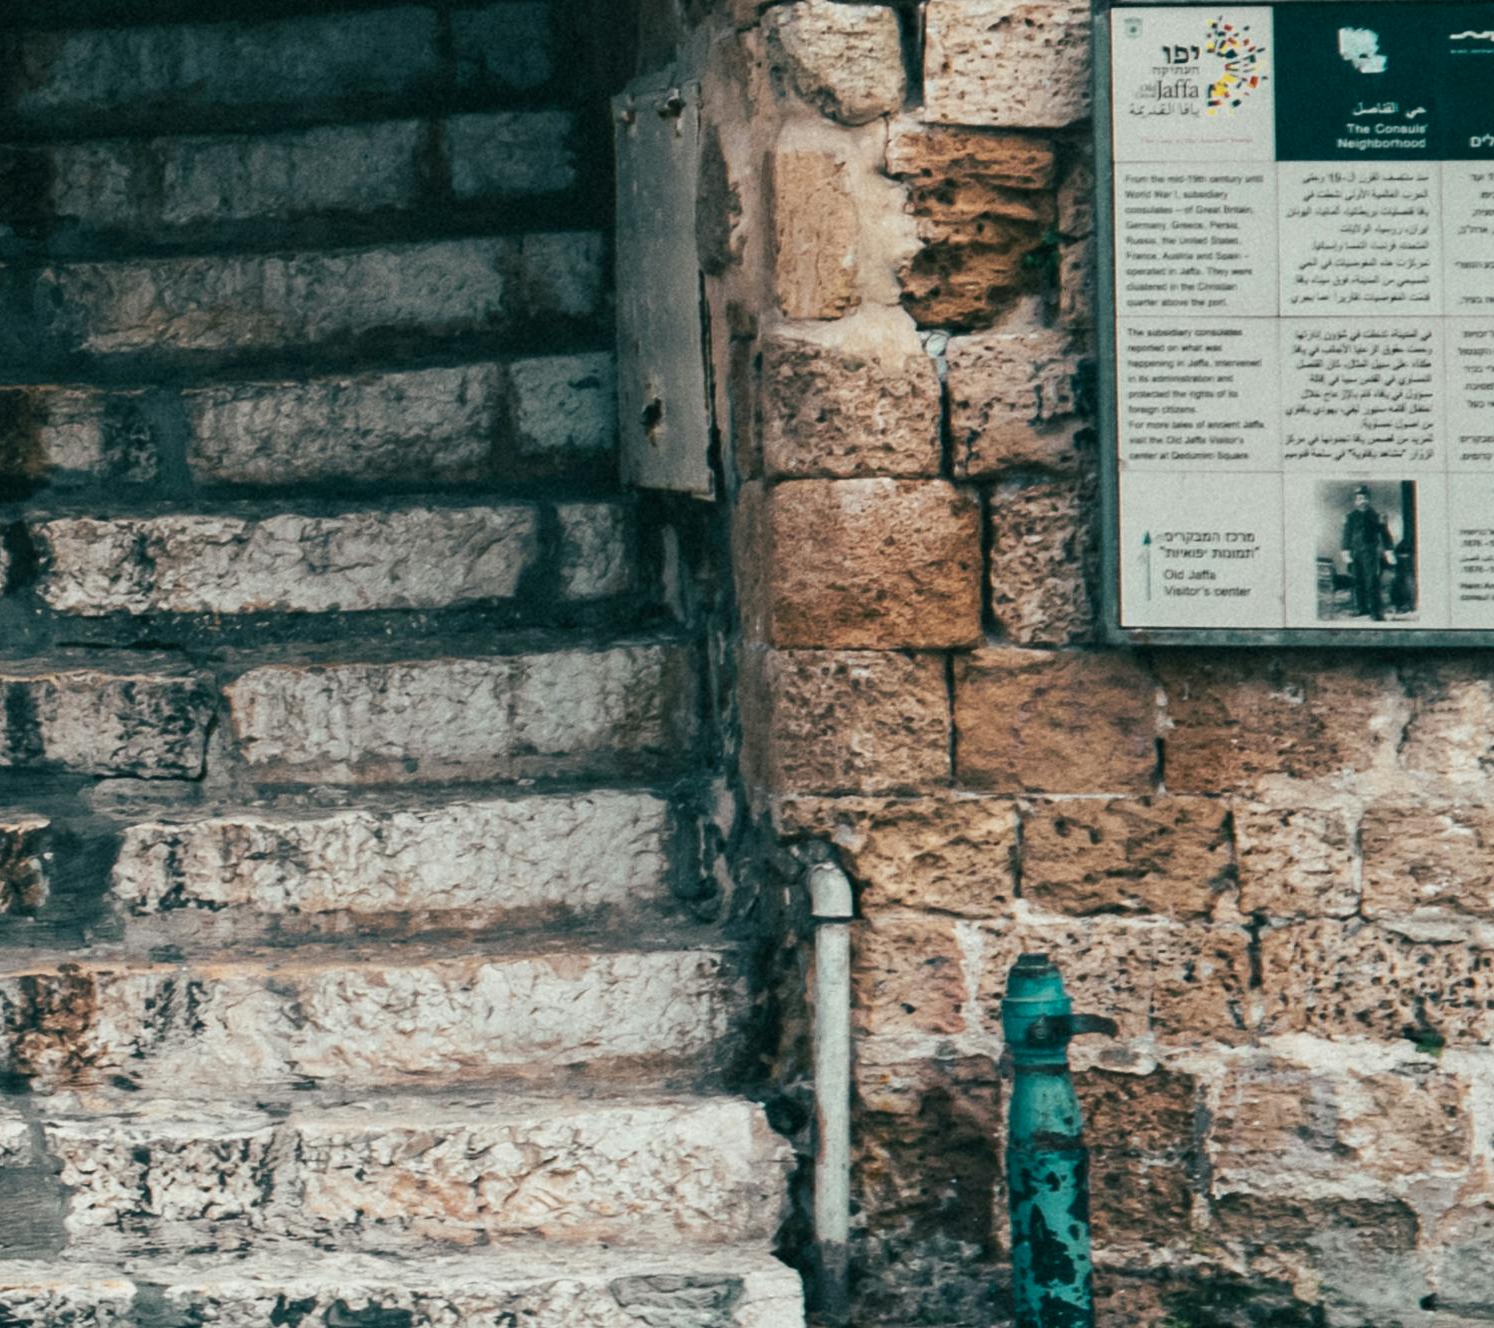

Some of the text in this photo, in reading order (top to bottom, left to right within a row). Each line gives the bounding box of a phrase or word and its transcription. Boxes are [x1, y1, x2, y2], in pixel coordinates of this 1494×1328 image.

[1161, 44, 1201, 65] יפו
[1155, 77, 1200, 102] Jaffa
[1346, 123, 1371, 134] The
[1337, 138, 1426, 150] Neighborhood
[1162, 568, 1217, 581] Old Jaffa
